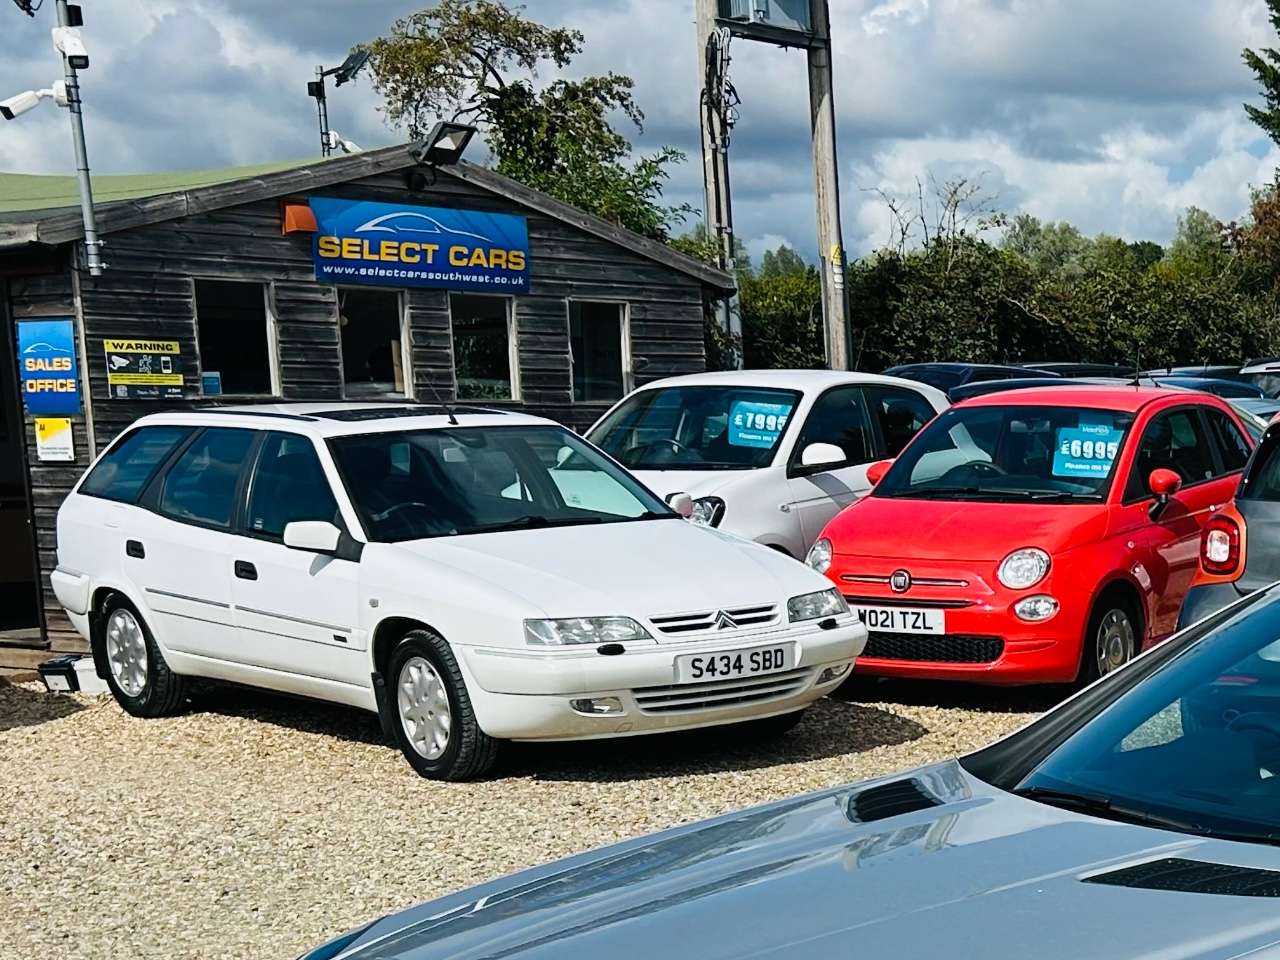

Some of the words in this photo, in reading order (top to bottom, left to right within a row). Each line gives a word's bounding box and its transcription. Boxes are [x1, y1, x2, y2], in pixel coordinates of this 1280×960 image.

[318, 236, 439, 264] SELECT
[449, 246, 526, 271] CARS
[322, 264, 525, 286] www.selectcarssouthwest.co.uk
[112, 342, 174, 352] WARNING
[25, 358, 73, 371] SALES
[26, 379, 76, 393] OFFICE
[1061, 439, 1118, 460] £6995
[899, 611, 933, 630] TZL
[691, 654, 744, 678] S434
[749, 648, 784, 672] SBD
